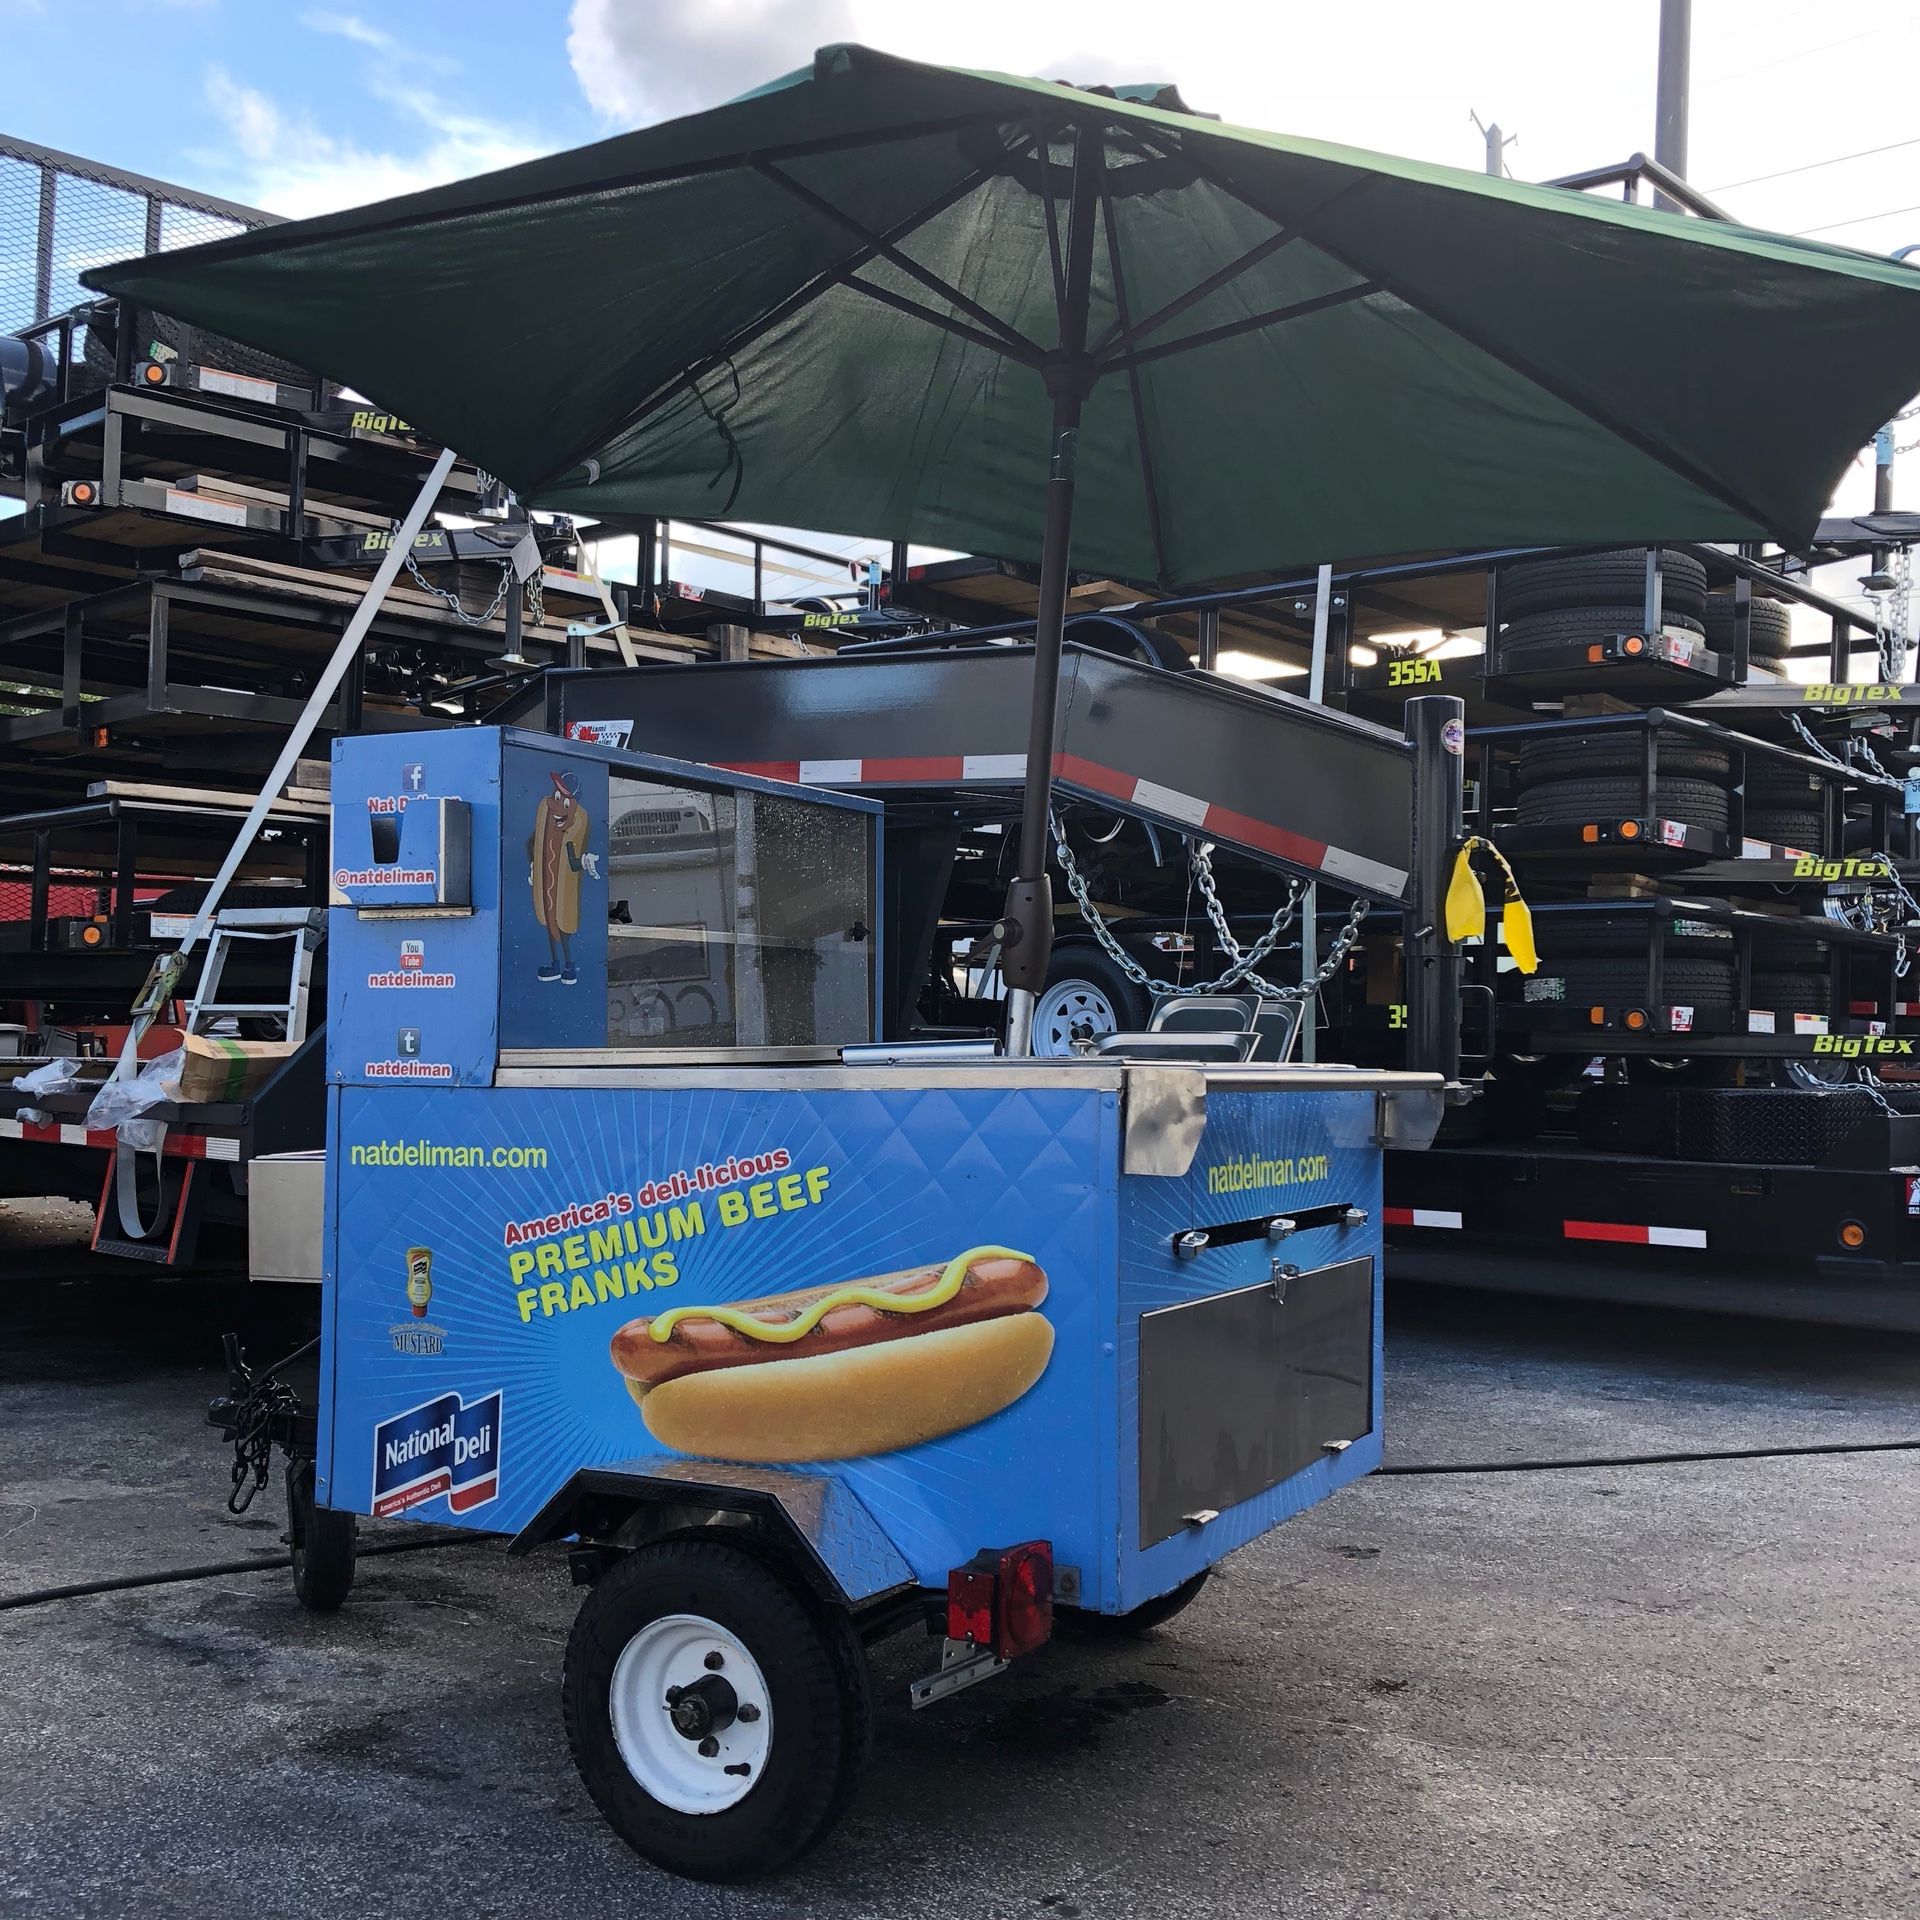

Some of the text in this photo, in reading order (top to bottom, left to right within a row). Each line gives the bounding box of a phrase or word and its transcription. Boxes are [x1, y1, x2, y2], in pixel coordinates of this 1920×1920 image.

[803, 612, 860, 628] BigTex
[1803, 683, 1905, 705] BigTex
[367, 798, 395, 813] Nat
[335, 869, 435, 887] @natdeliman
[1793, 858, 1895, 881] BigTex
[406, 942, 419, 953] You
[405, 956, 420, 966] Tube
[368, 971, 455, 988] natdeliman
[1813, 1034, 1915, 1058] BigTex
[366, 1060, 452, 1077] natdeliman
[351, 1139, 548, 1169] natdeliman.com
[1208, 1152, 1328, 1195] natdeliman.com
[504, 1148, 791, 1248] America's deli-licious
[509, 1166, 831, 1286] PREMIUM BEEF
[517, 1251, 680, 1324] FRANKS
[394, 1332, 443, 1354] MUSTARD
[385, 1413, 491, 1470] National Deli
